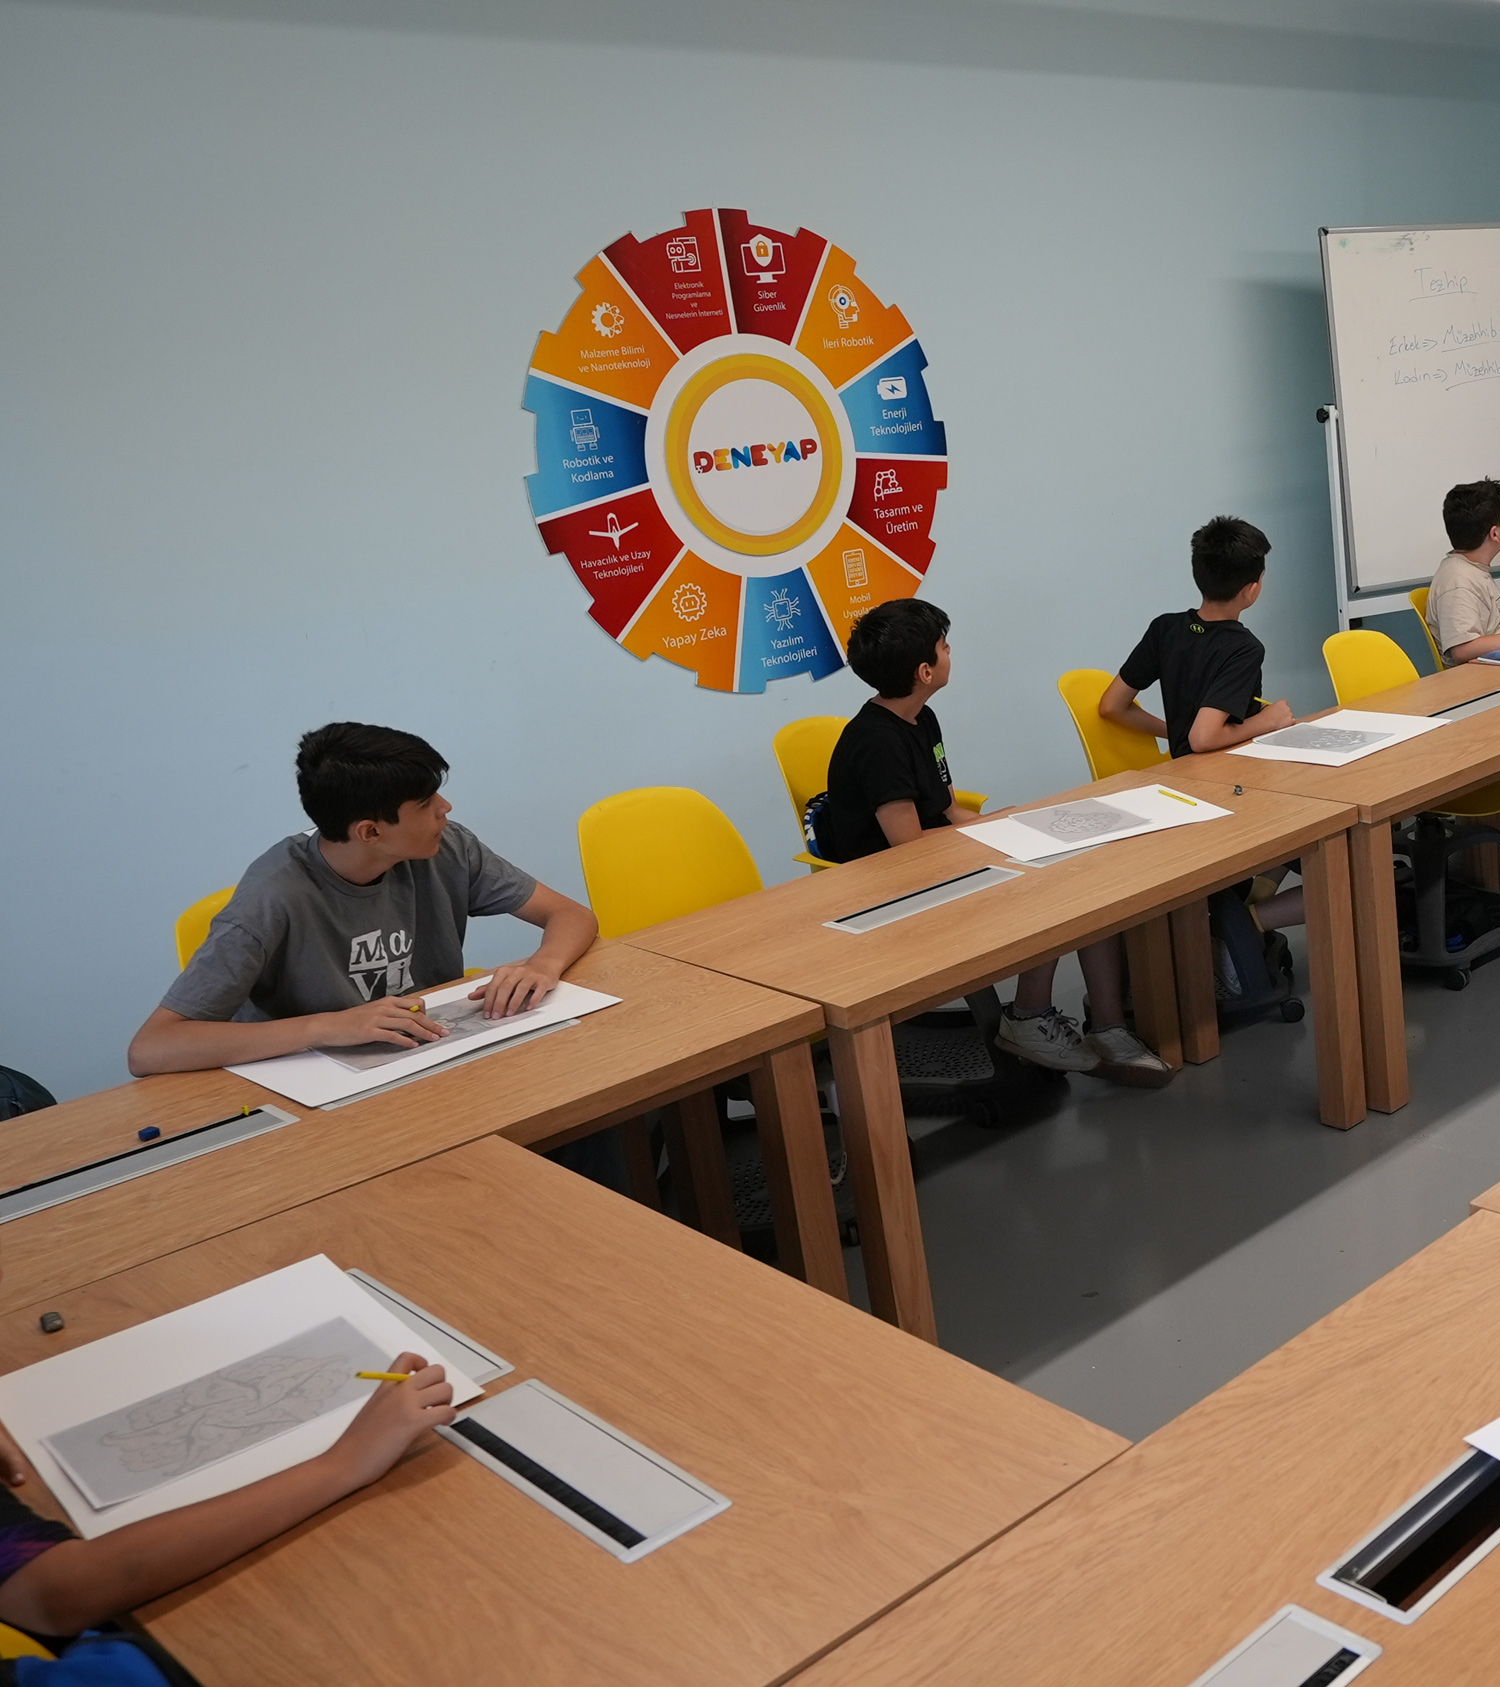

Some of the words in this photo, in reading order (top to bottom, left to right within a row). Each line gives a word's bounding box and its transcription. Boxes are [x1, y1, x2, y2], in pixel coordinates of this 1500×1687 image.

[674, 281, 704, 290] Elektronik
[1413, 266, 1468, 295] Tezhip
[671, 291, 712, 300] Programlama
[757, 290, 777, 299] Siber
[753, 302, 787, 312] Güvenlik
[666, 311, 698, 319] Nesnelerin
[823, 337, 839, 349] İleri
[841, 336, 875, 347] Robotik
[580, 347, 620, 359] Malzeme
[622, 345, 645, 356] Bilimi
[591, 358, 651, 371] Nanoteknoloji
[881, 407, 908, 420] Enerji
[870, 421, 923, 436] Teknolojileri
[562, 456, 601, 469] Robotik
[602, 455, 614, 463] ve
[693, 438, 818, 474] DENEYAP
[571, 470, 614, 483] Kodlama
[873, 505, 911, 519] Tasarım
[912, 503, 923, 513] ve
[886, 521, 919, 535] Üretim
[580, 555, 618, 569] Havacılık
[631, 550, 652, 561] Uzay
[593, 563, 645, 580] Teknolojileri
[849, 592, 871, 605] Mobil
[843, 606, 878, 619] Uygula
[662, 633, 697, 649] Yapay
[699, 626, 727, 641] Zeka
[770, 635, 804, 650] Yazılım
[761, 646, 818, 668] Teknolojileri
